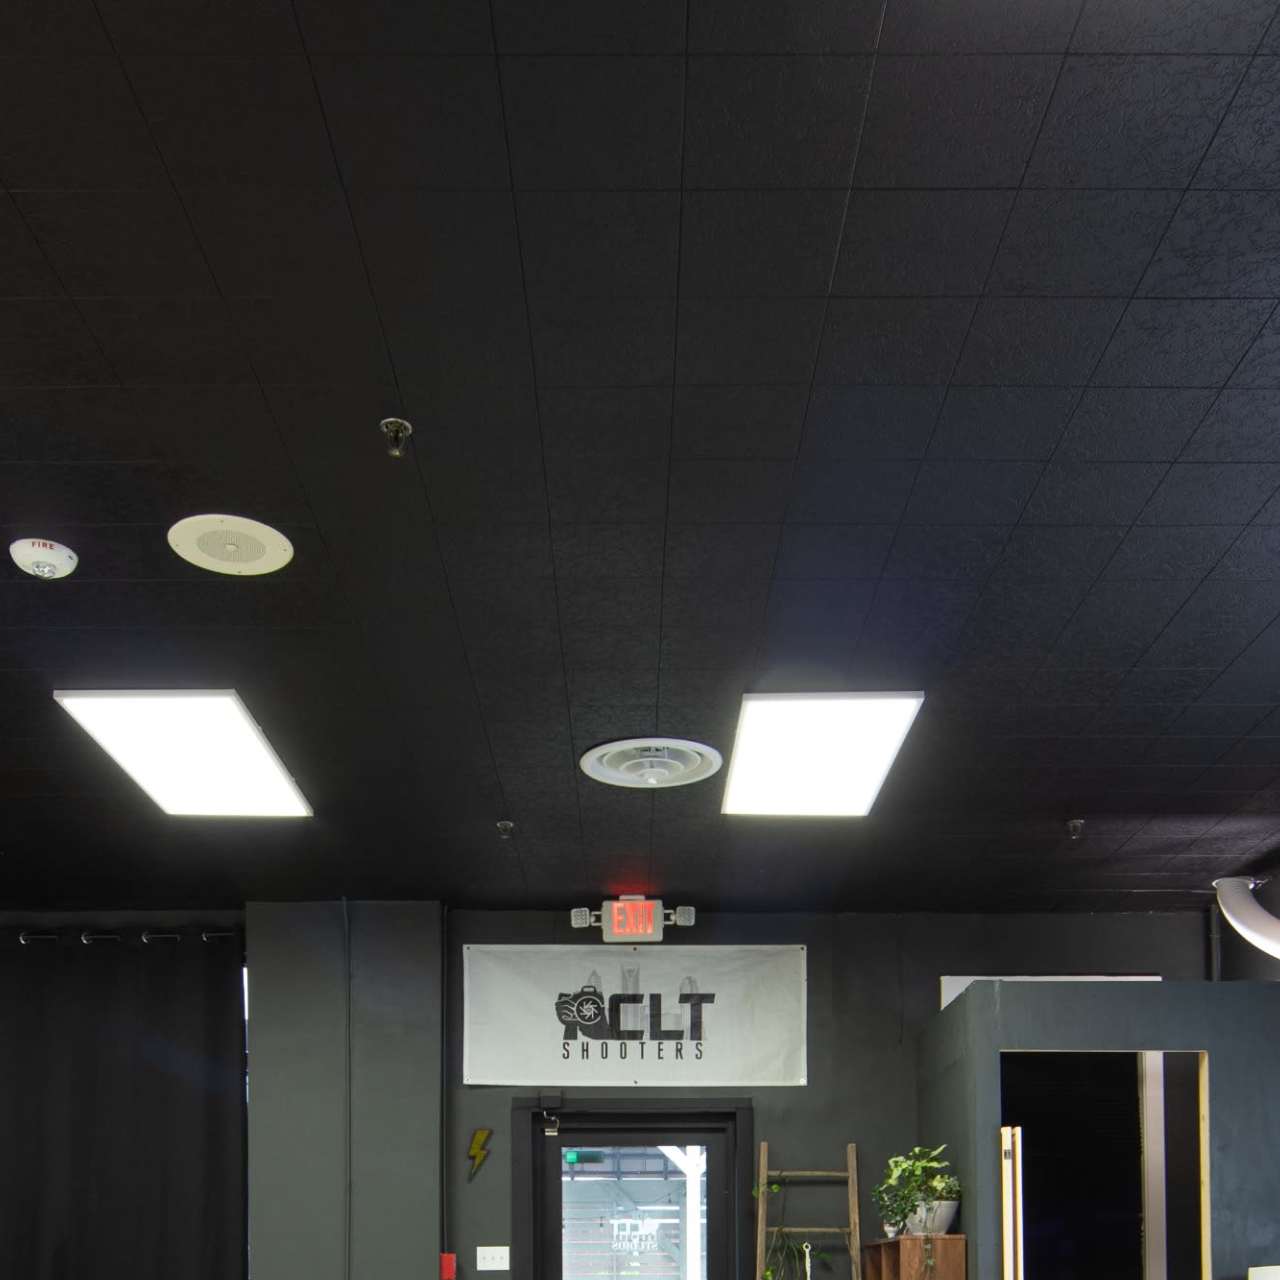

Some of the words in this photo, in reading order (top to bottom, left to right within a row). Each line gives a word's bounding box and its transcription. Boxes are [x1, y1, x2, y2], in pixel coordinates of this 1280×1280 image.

[32, 541, 55, 550] FIRE
[612, 902, 655, 935] EXIT
[609, 993, 716, 1041] CLT
[562, 1041, 704, 1060] SHOOTERS
